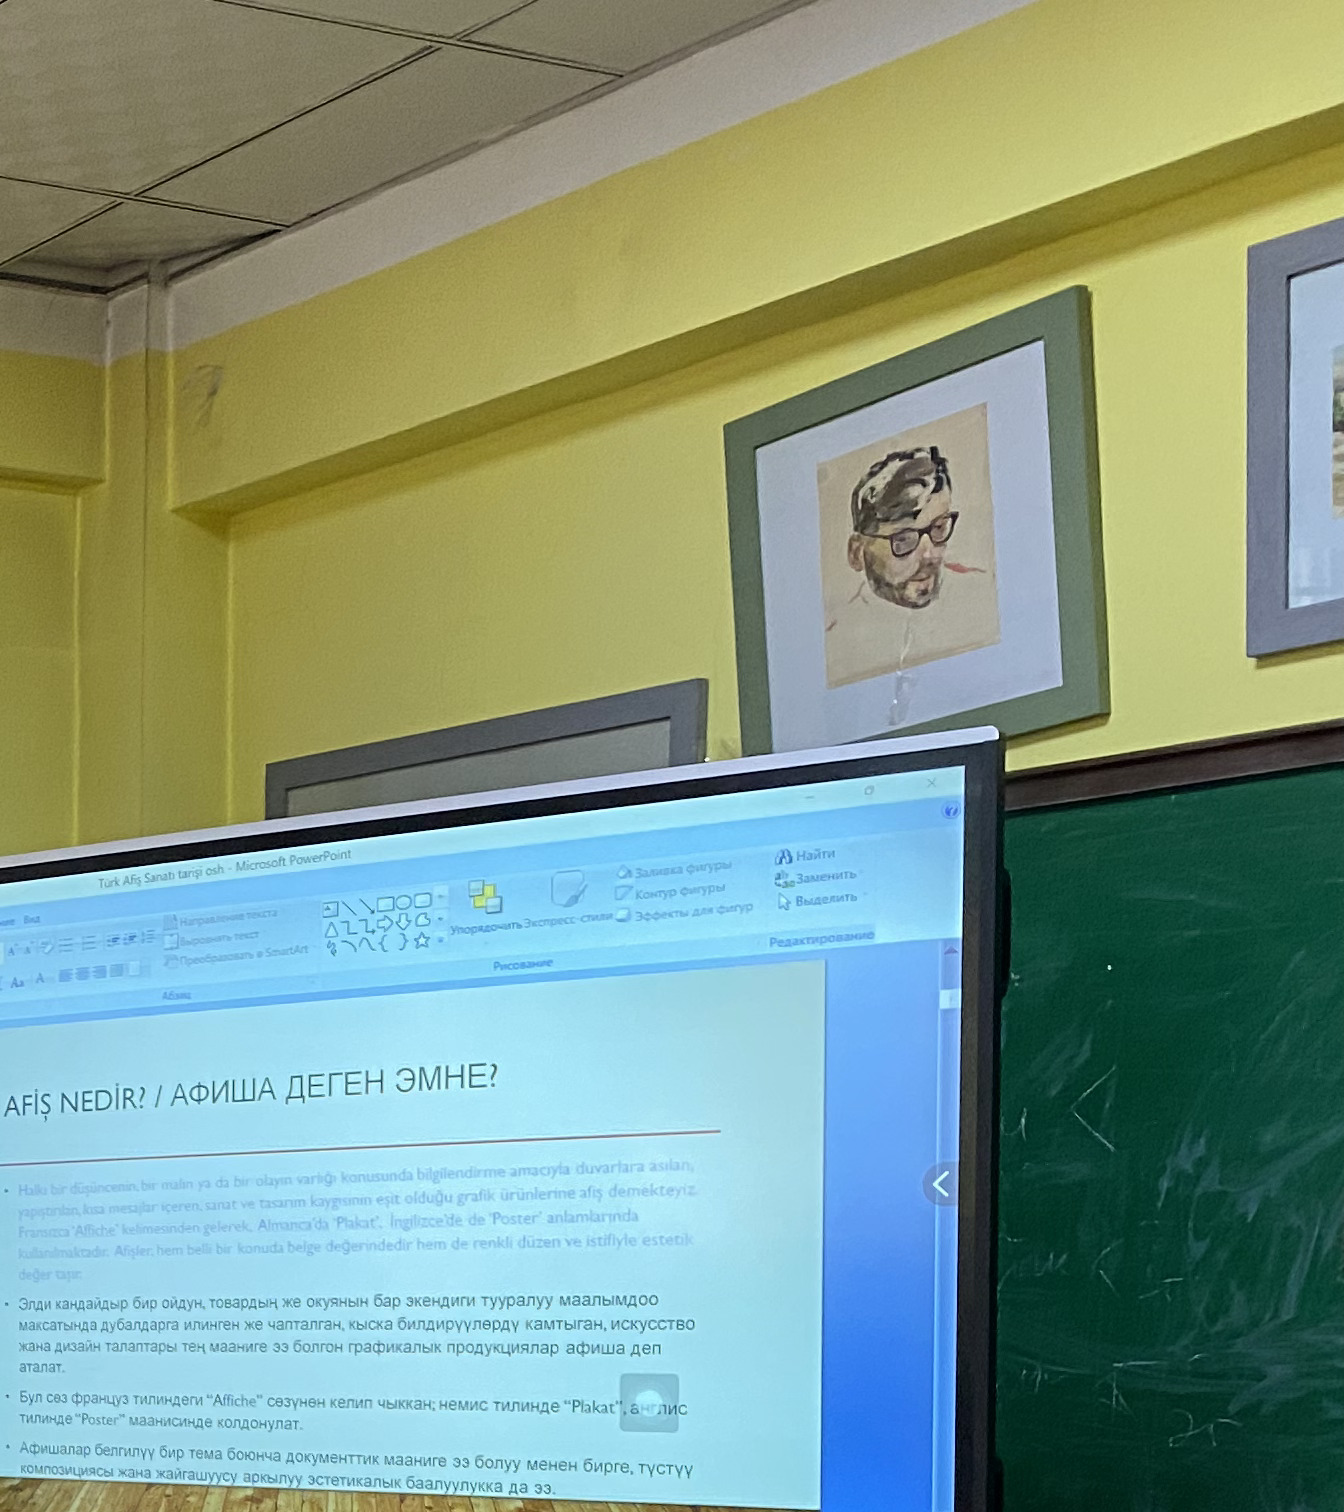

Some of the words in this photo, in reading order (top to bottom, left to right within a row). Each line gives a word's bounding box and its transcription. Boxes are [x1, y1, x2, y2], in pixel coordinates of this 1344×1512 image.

[205, 863, 225, 876] osh
[236, 855, 287, 872] Microsoft
[289, 848, 352, 867] PowerPoint
[796, 848, 836, 863] Найти
[635, 864, 683, 880] Заливка
[686, 860, 733, 877] фигуры
[796, 869, 857, 886] Заменить
[635, 888, 677, 903] Контур
[679, 882, 726, 900] фигуры
[796, 892, 858, 908] Выделить
[450, 920, 523, 937] Упорядочить
[523, 911, 614, 930] Экспресс-стили
[635, 907, 689, 923] Эффекты
[769, 930, 875, 949] Редактирование
[493, 957, 554, 972] Рисование
[4, 1088, 51, 1122] AFİŞ
[60, 1083, 146, 1114] NEDİR?
[155, 1084, 163, 1108] /
[170, 1076, 277, 1108] АФИША
[285, 1069, 385, 1105] ДЕГЕН
[395, 1062, 499, 1094] ЭМНЕ?
[215, 1177, 230, 1190] da
[341, 1167, 413, 1183] konusunda
[417, 1164, 505, 1184] bilgilendirme
[510, 1162, 571, 1180] amacıyla
[576, 1160, 644, 1176] duvarlara
[206, 1198, 237, 1211] sanat
[241, 1199, 255, 1210] ve
[405, 1189, 453, 1208] olduğu
[457, 1187, 494, 1206] grafik
[501, 1187, 576, 1203] ürünlerine
[580, 1185, 603, 1203] afiş
[468, 1212, 485, 1225] de
[547, 1208, 639, 1225] anlamlarında
[237, 1242, 283, 1254] konuda
[288, 1240, 315, 1257] belge
[326, 1238, 413, 1256] değerindedir
[417, 1237, 447, 1250] hem
[451, 1236, 468, 1250] de
[473, 1234, 513, 1250] renkli
[518, 1233, 561, 1249] düzen
[565, 1236, 582, 1248] ve
[586, 1233, 637, 1251] istifiyle
[19, 1297, 51, 1311] Элди
[56, 1296, 128, 1313] кандайдыр
[132, 1296, 157, 1313] бир
[162, 1297, 206, 1311] ойдун,
[209, 1297, 278, 1311] товардың
[282, 1297, 301, 1308] же
[306, 1296, 369, 1310] окуянын
[373, 1293, 401, 1309] бар
[406, 1294, 476, 1308] экендиги
[481, 1294, 553, 1310] тууралуу
[559, 1293, 659, 1307] маалымдоо
[19, 1319, 97, 1333] максатында
[101, 1317, 179, 1334] дубалдарга
[184, 1320, 240, 1331] илинген
[244, 1320, 263, 1331] же
[268, 1319, 345, 1332] чапталган,
[349, 1320, 393, 1331] кыска
[397, 1316, 519, 1334] билдирүүлөрдү
[525, 1319, 607, 1332] камтыган,
[611, 1319, 696, 1335] искусство
[19, 1341, 51, 1353] жана
[55, 1340, 101, 1354] дизайн
[105, 1341, 177, 1355] талаптары
[182, 1342, 206, 1354] тең
[210, 1341, 267, 1353] мааниге
[273, 1342, 289, 1353] ээ
[293, 1339, 343, 1353] болгон
[348, 1341, 442, 1356] графикалык
[446, 1341, 559, 1357] продукциялар
[565, 1341, 626, 1357] афиша
[630, 1343, 662, 1357] деп
[19, 1361, 66, 1373] аталат.
[19, 1390, 43, 1404] Бул
[46, 1392, 68, 1404] сөз
[72, 1391, 129, 1408] француз
[133, 1394, 203, 1407] тилиндеги
[267, 1396, 326, 1411] сөзүнөн
[330, 1398, 373, 1410] келип
[439, 1399, 489, 1411] немис
[493, 1401, 560, 1415] тилинде
[20, 1413, 72, 1426] тилинде
[129, 1416, 213, 1430] маанисинде
[217, 1418, 304, 1432] колдонулат.
[20, 1440, 91, 1457] Афишалар
[94, 1442, 155, 1461] белгилүү
[159, 1445, 185, 1461] бир
[189, 1448, 222, 1460] тема
[227, 1447, 282, 1463] боюнча
[286, 1451, 380, 1466] документтик
[384, 1455, 448, 1468] мааниге
[452, 1456, 470, 1468] ээ
[474, 1455, 521, 1473] болуу
[527, 1459, 578, 1472] менен
[583, 1457, 634, 1476] бирге,
[638, 1463, 694, 1479] түстүү
[20, 1464, 114, 1479] композициясы
[118, 1467, 151, 1479] жана
[156, 1466, 238, 1486] жайгашуусу
[243, 1471, 303, 1488] аркылуу
[307, 1473, 402, 1490] эстетикалык
[405, 1475, 504, 1496] баалуулукка
[508, 1482, 528, 1496] да
[534, 1482, 556, 1496] ээ.
